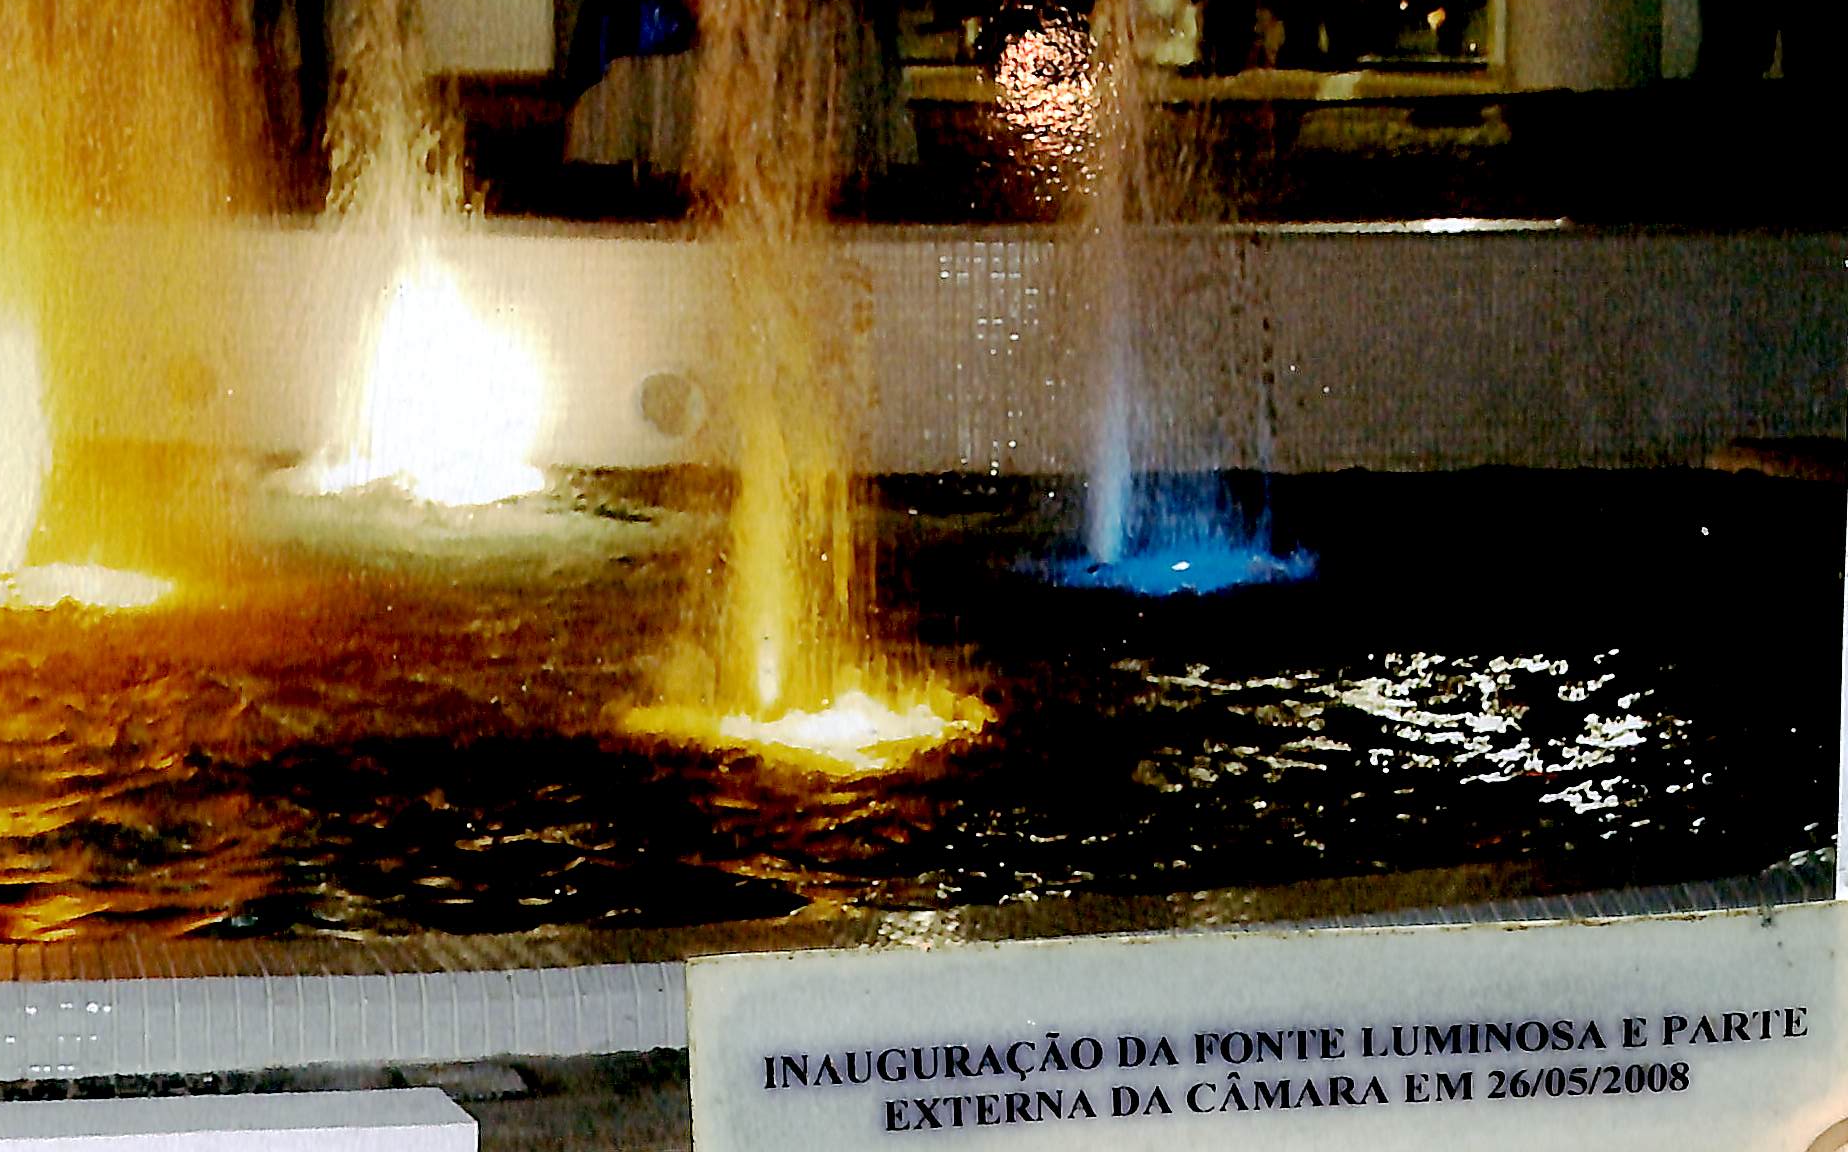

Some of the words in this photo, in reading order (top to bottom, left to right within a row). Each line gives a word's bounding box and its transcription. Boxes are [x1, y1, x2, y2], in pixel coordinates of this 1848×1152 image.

[764, 1032, 1104, 1090] INAUGURAÇÃO
[1117, 1036, 1180, 1068] DA
[1194, 1027, 1346, 1065] FONTE
[1361, 1020, 1607, 1058] LUMINOSA
[1622, 1017, 1648, 1048] E
[1661, 1007, 1808, 1046] PARTE
[885, 1089, 1097, 1132] EXTERNA
[1111, 1085, 1173, 1117] DA
[1186, 1071, 1389, 1113] CÂMARA
[1404, 1071, 1473, 1103] EM
[1487, 1062, 1690, 1099] 26/05/2008
